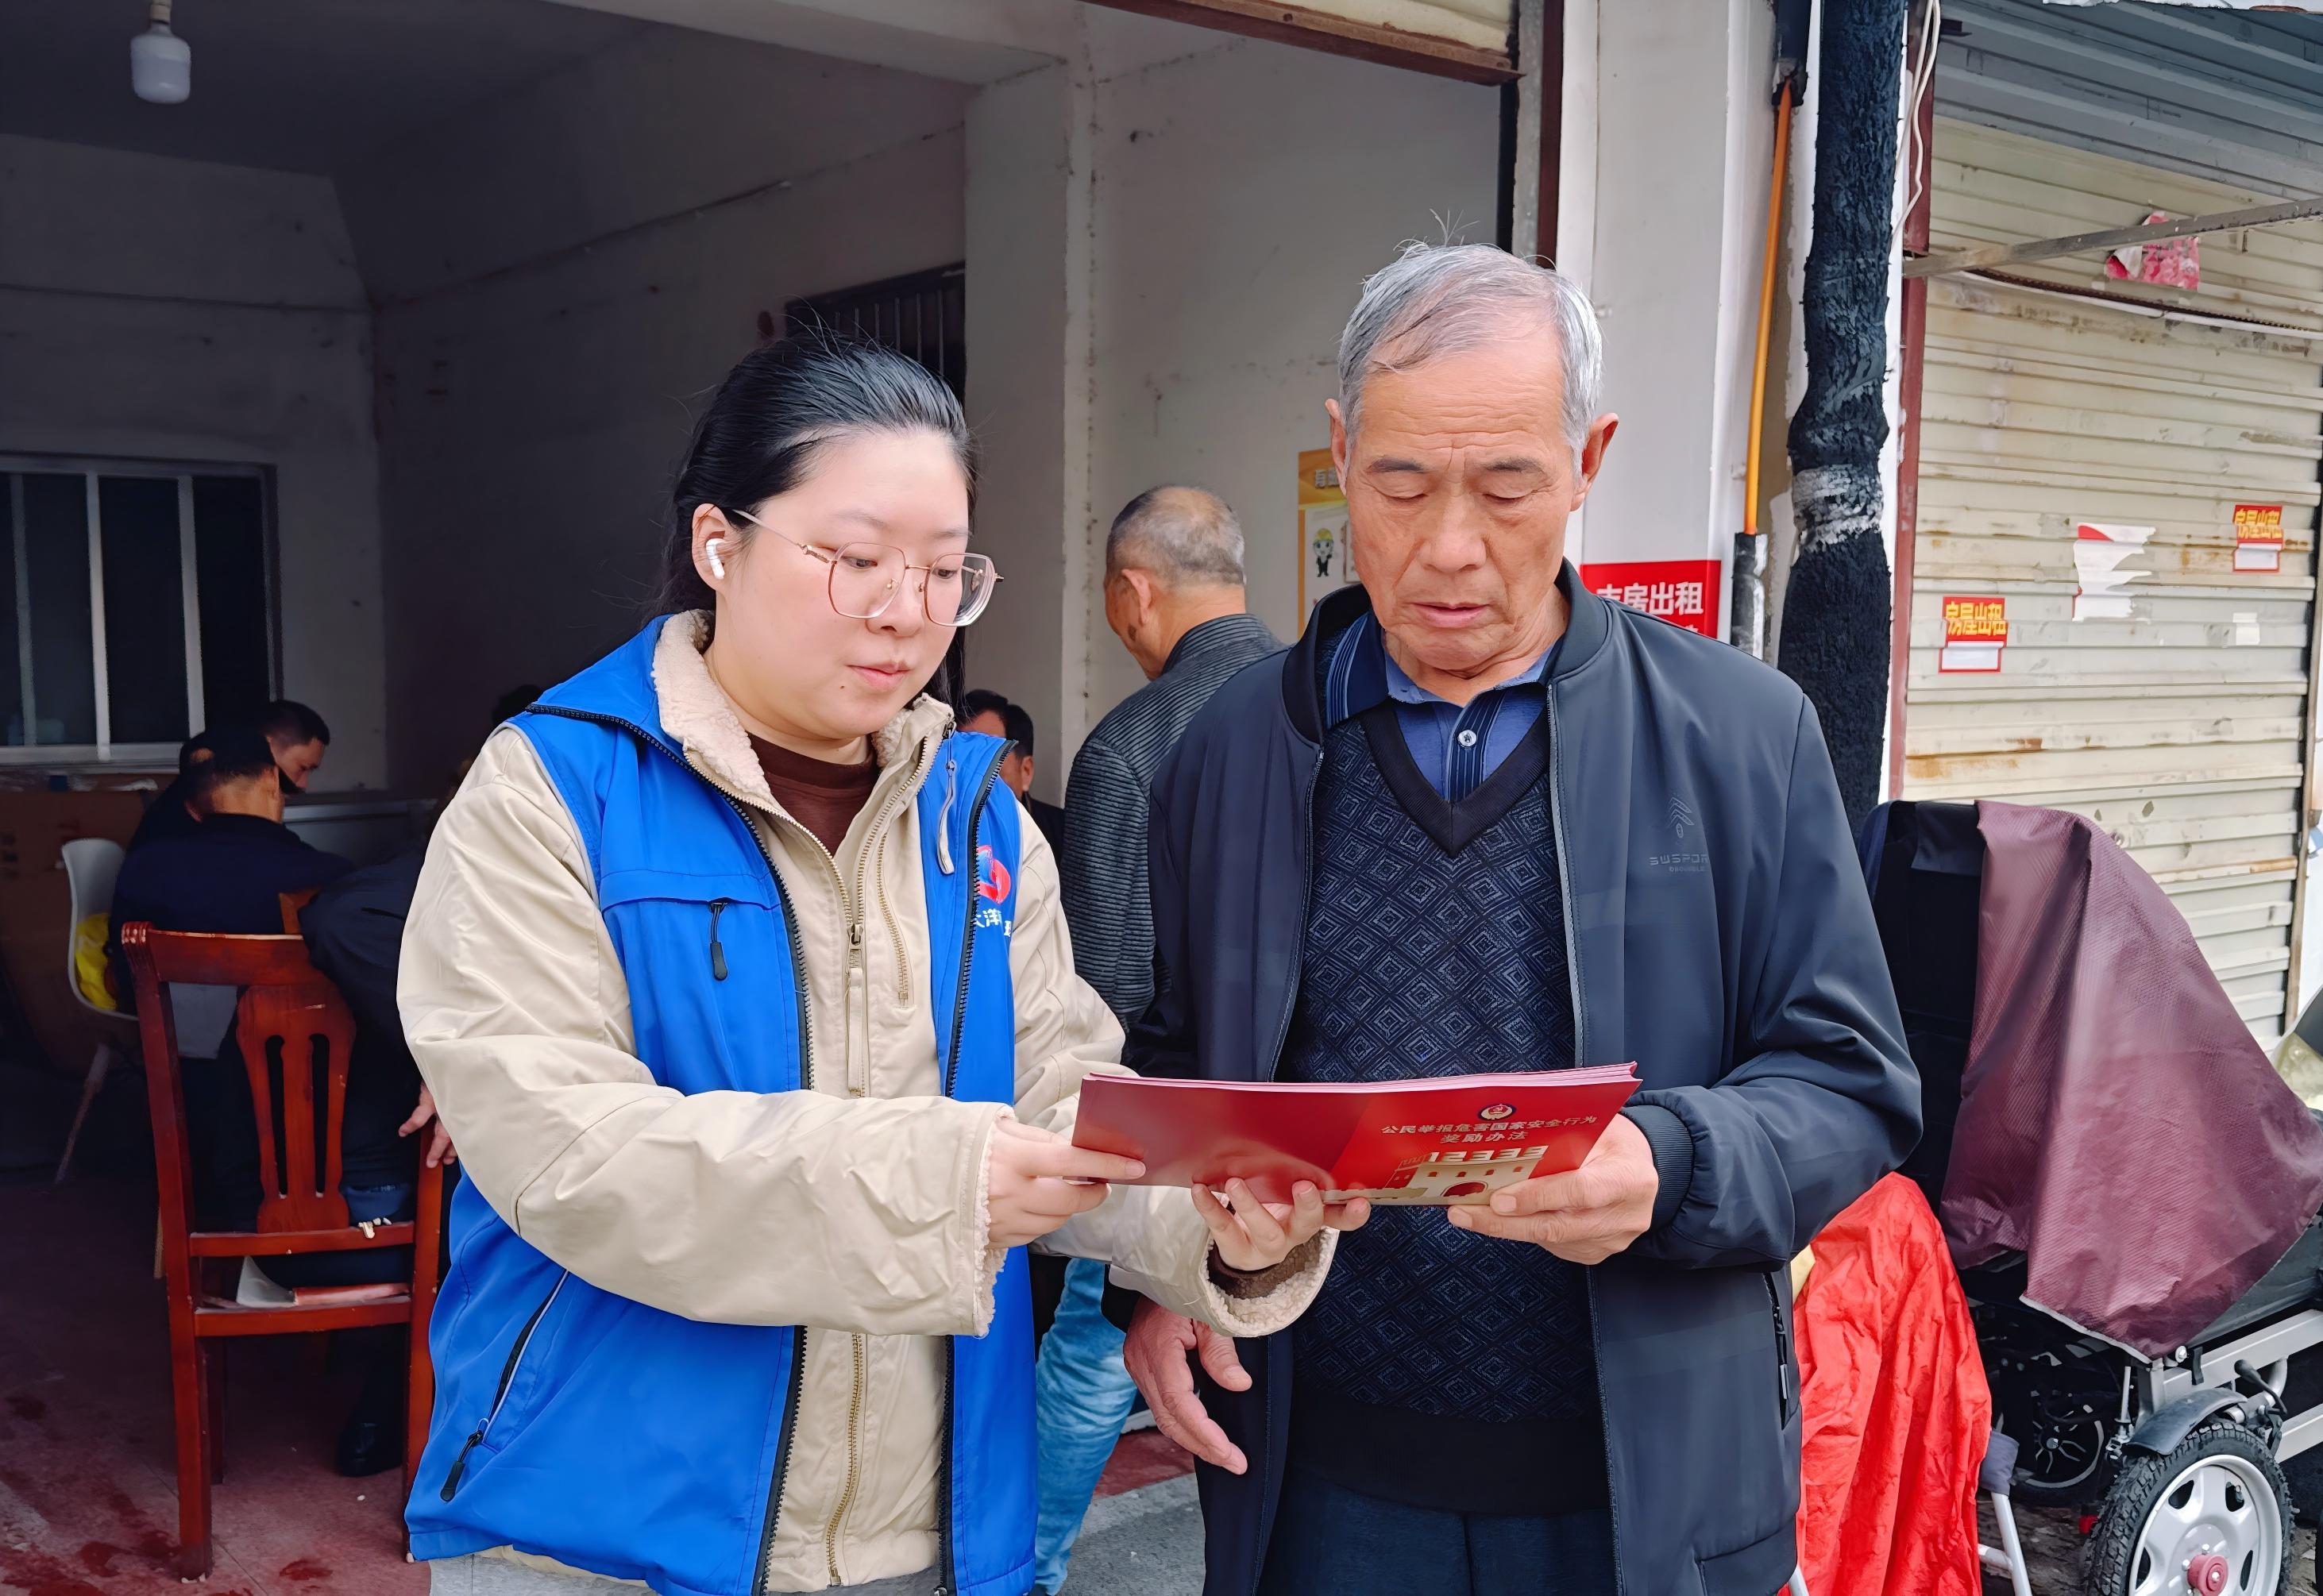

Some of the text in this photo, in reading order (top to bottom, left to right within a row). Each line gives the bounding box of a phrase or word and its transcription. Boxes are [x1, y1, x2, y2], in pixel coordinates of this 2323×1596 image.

[1381, 1116, 1597, 1134] 公民举报危害国家安全行为
[1440, 1131, 1528, 1143] 奖励办法
